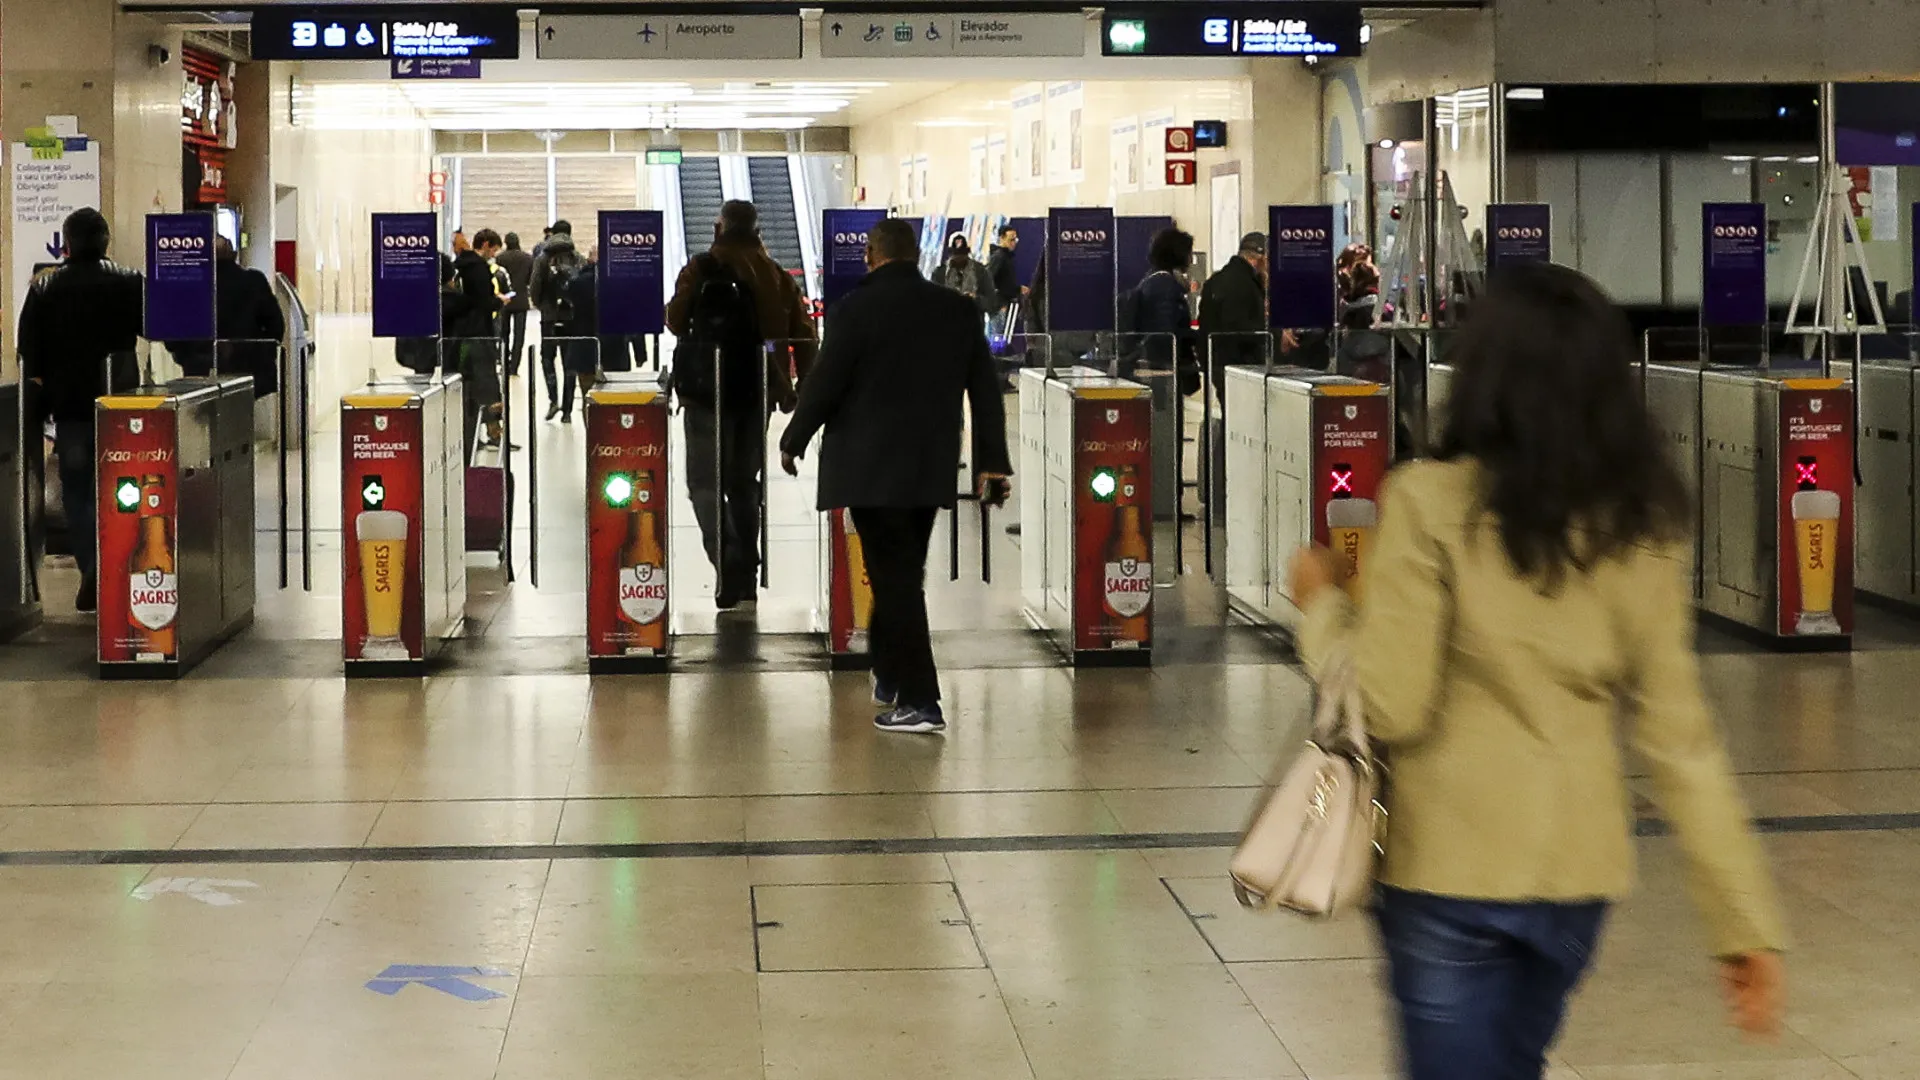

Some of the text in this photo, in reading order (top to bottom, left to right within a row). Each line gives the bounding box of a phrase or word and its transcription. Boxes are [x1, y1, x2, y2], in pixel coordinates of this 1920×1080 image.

[434, 22, 459, 36] Exit
[676, 23, 735, 36] Aeroporto
[961, 20, 1009, 32] Elevador
[1283, 19, 1307, 34] Exit
[353, 442, 410, 450] PORTUGUESE
[353, 451, 371, 459] FOR
[1808, 523, 1825, 570] SAGRES
[374, 544, 391, 593] SAGRES
[621, 584, 667, 600] SAGRES
[1106, 577, 1151, 594] SAGRES
[132, 589, 177, 606] SAGRES
